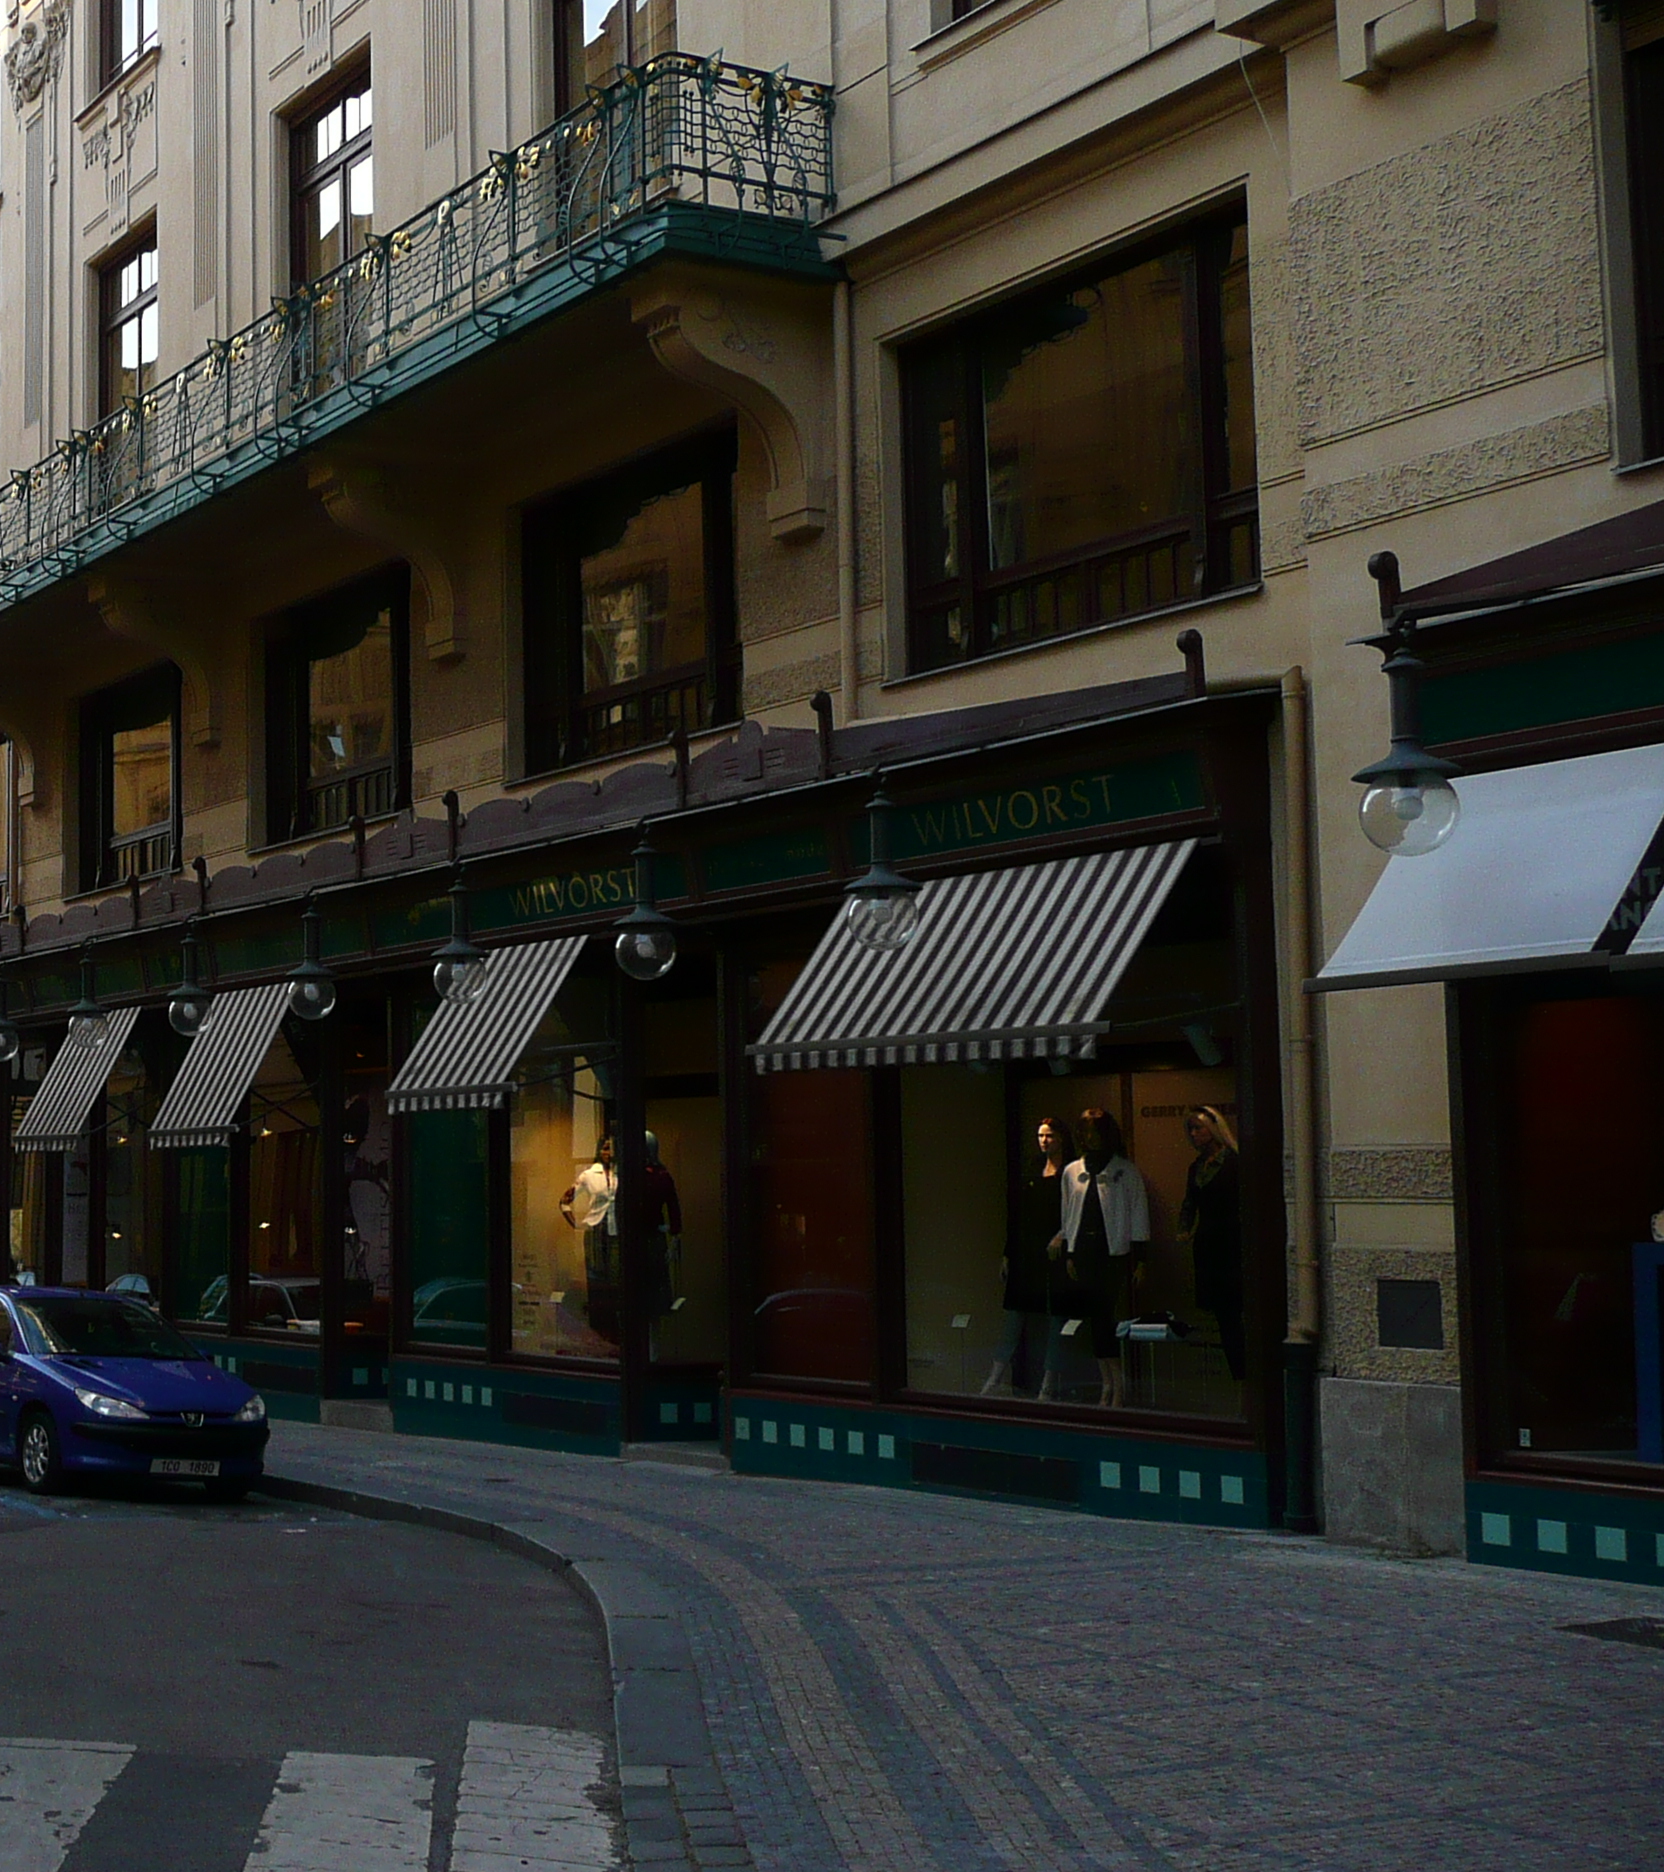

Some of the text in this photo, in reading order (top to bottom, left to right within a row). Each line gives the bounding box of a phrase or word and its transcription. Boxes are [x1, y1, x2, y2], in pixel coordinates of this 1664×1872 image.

[910, 774, 1115, 846] WILVORST
[508, 867, 636, 917] WILVORST
[1140, 1105, 1186, 1118] GERRY
[189, 1462, 215, 1474] 1890
